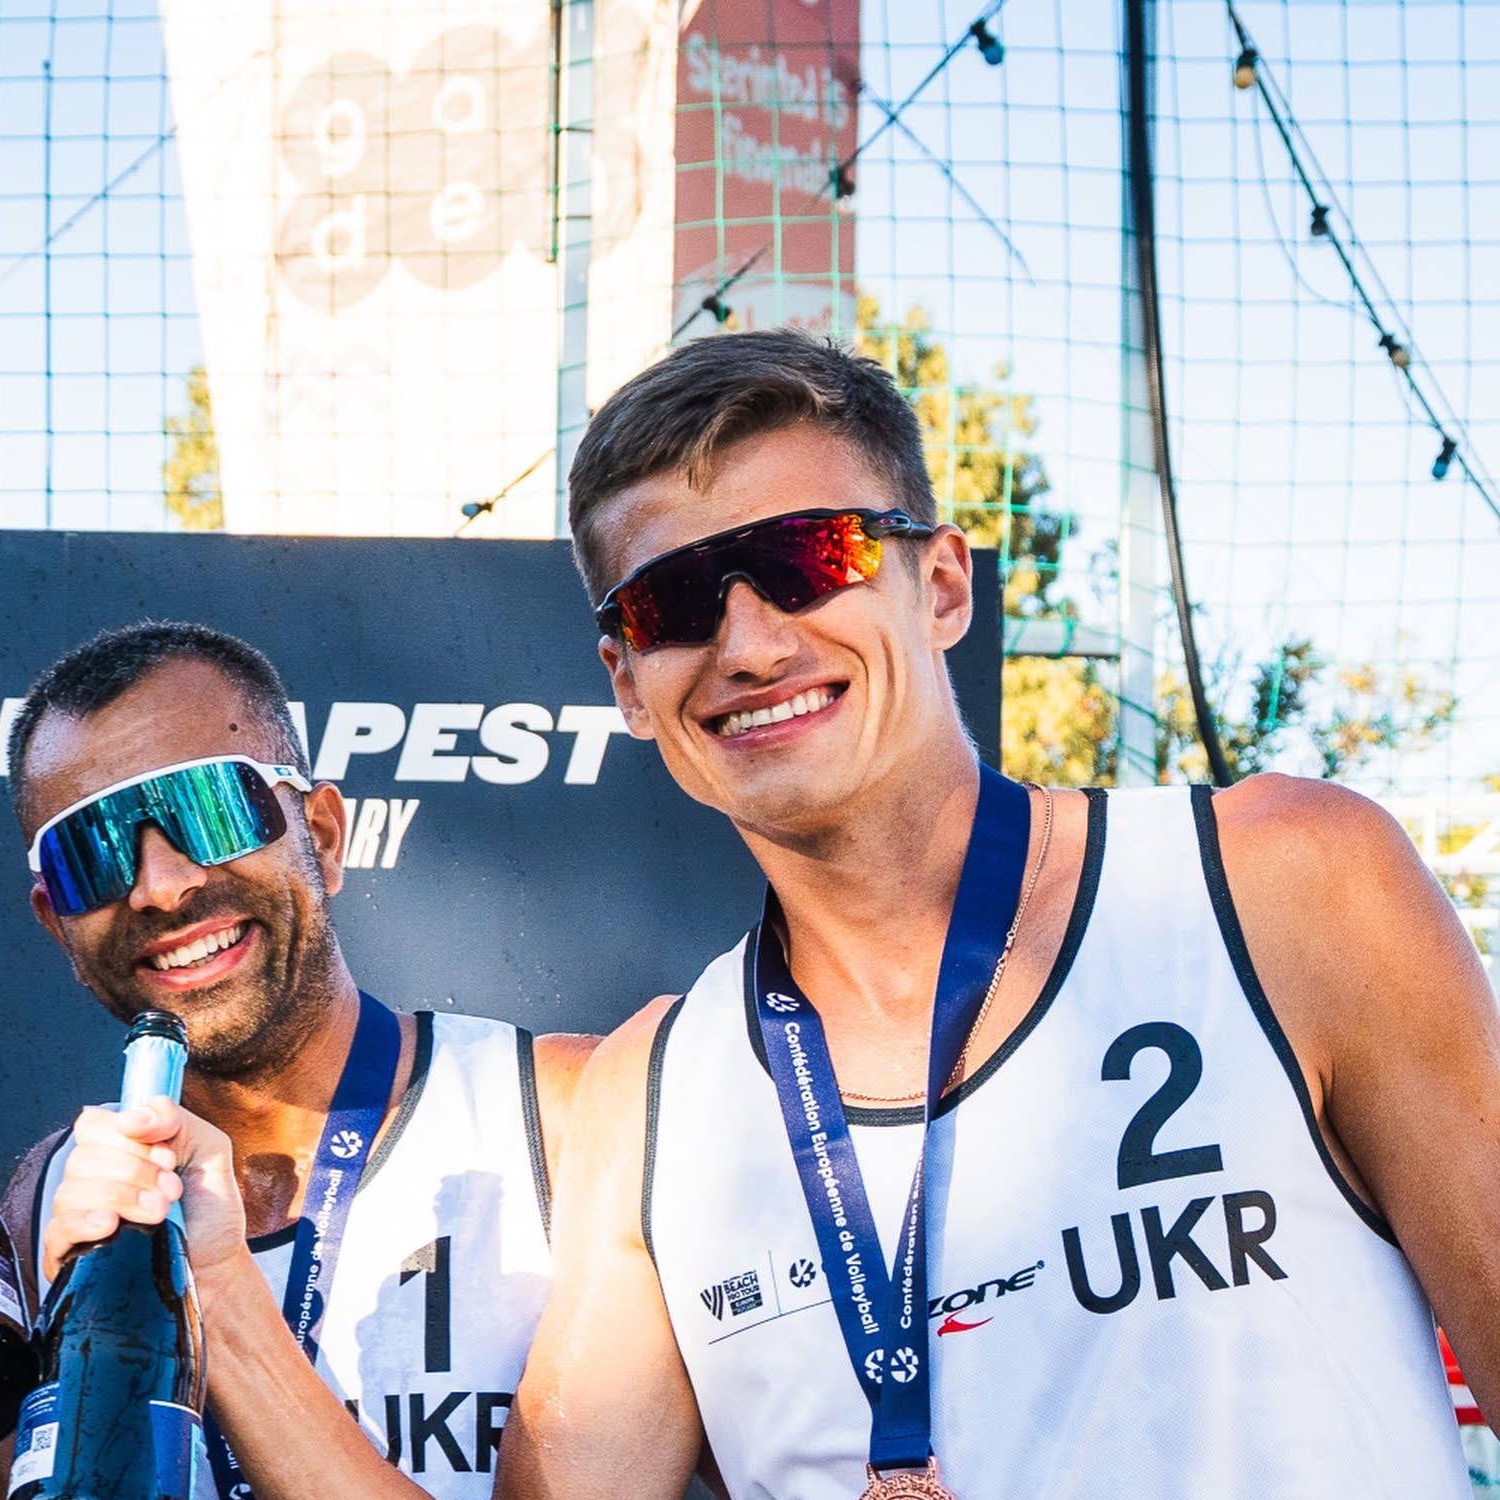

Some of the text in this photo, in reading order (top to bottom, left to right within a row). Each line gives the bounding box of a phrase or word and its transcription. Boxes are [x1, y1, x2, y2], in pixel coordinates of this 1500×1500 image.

[1101, 1022, 1224, 1190] 2
[313, 1169, 343, 1239] Volleyball
[784, 1022, 881, 1335] Confédération Européenne de Volleyball
[400, 1236, 451, 1373] 1
[723, 1273, 759, 1294] BEACH
[900, 1204, 919, 1329] Confédération
[1061, 1190, 1289, 1315] UKR
